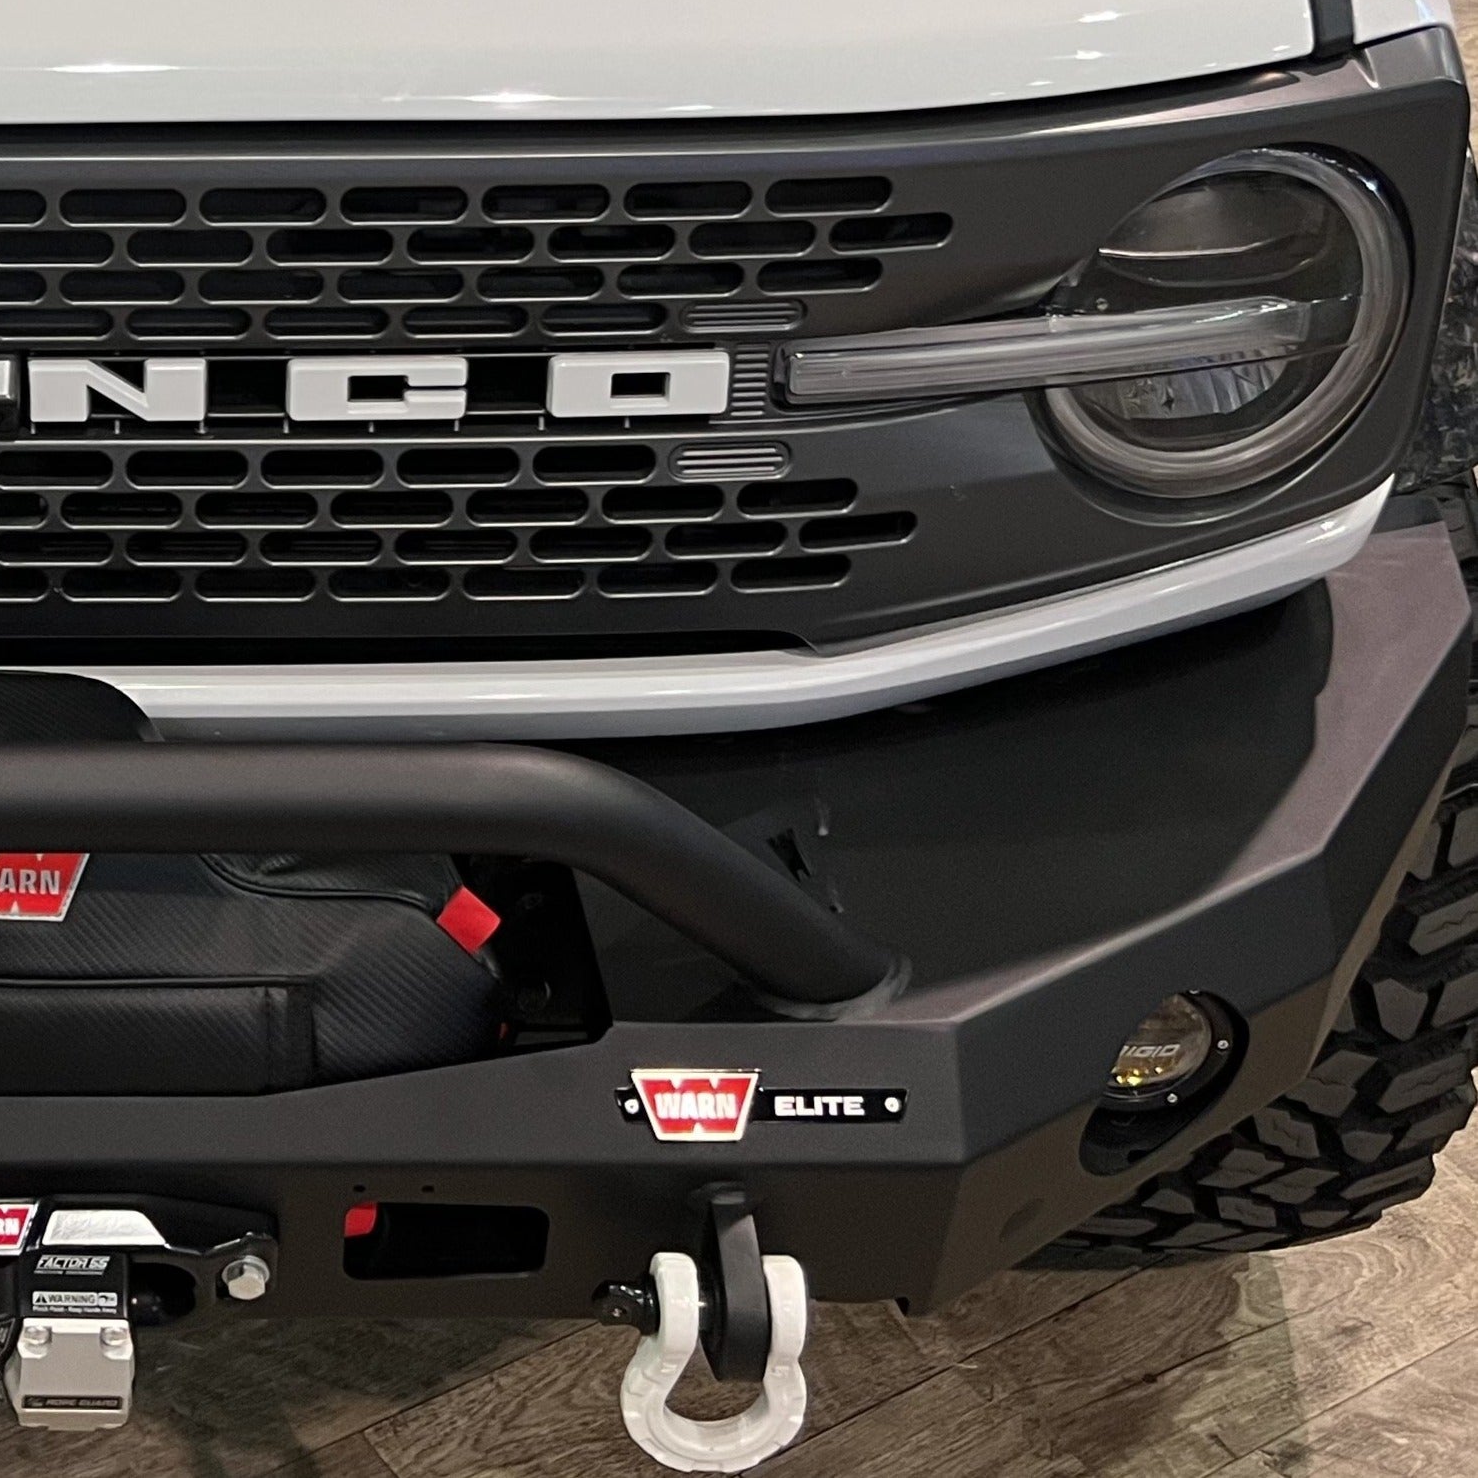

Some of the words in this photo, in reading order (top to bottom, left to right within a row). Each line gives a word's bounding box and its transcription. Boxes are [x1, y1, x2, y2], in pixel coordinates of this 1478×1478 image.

[653, 1092, 738, 1120] WARN
[774, 1095, 866, 1117] ELITE
[47, 1294, 96, 1304] WARNING
